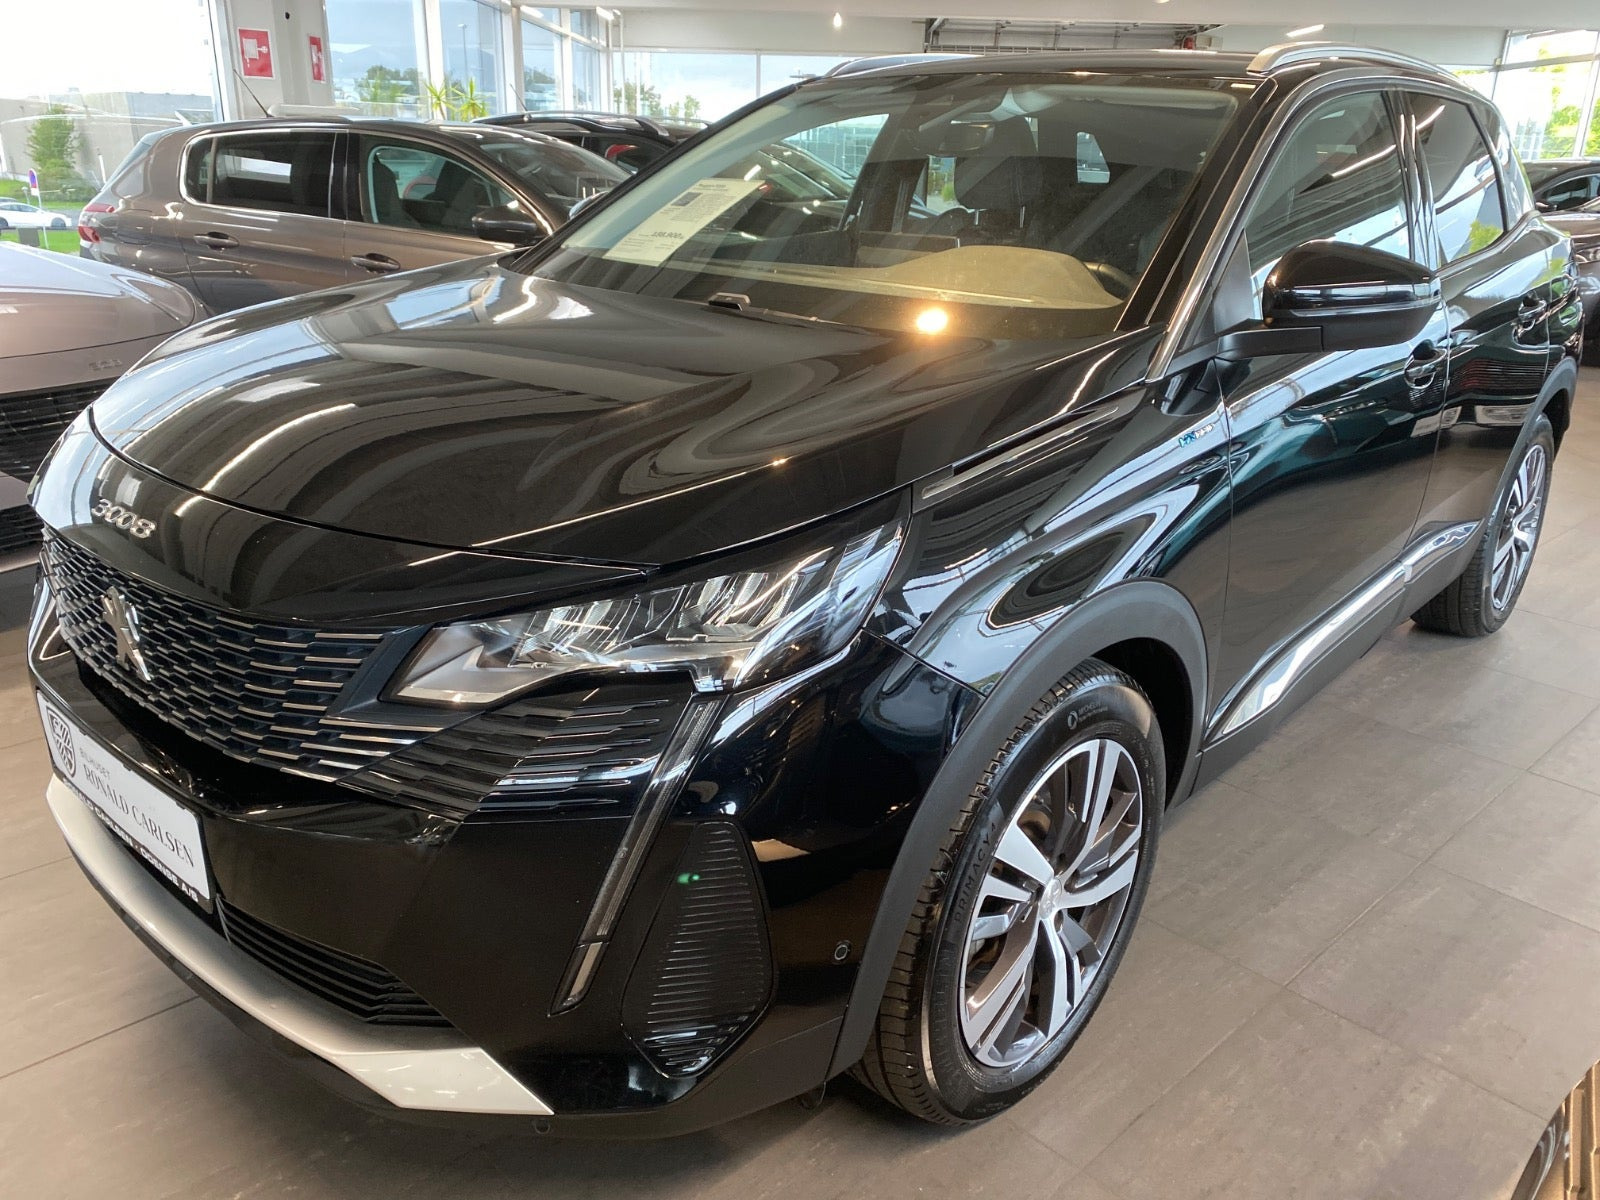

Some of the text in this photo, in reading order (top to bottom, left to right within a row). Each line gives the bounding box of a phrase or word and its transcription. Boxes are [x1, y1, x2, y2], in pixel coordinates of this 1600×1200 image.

[91, 498, 157, 538] 3008
[83, 763, 194, 868] RONALD CARLSEN
[954, 832, 990, 922] PRIMACY
